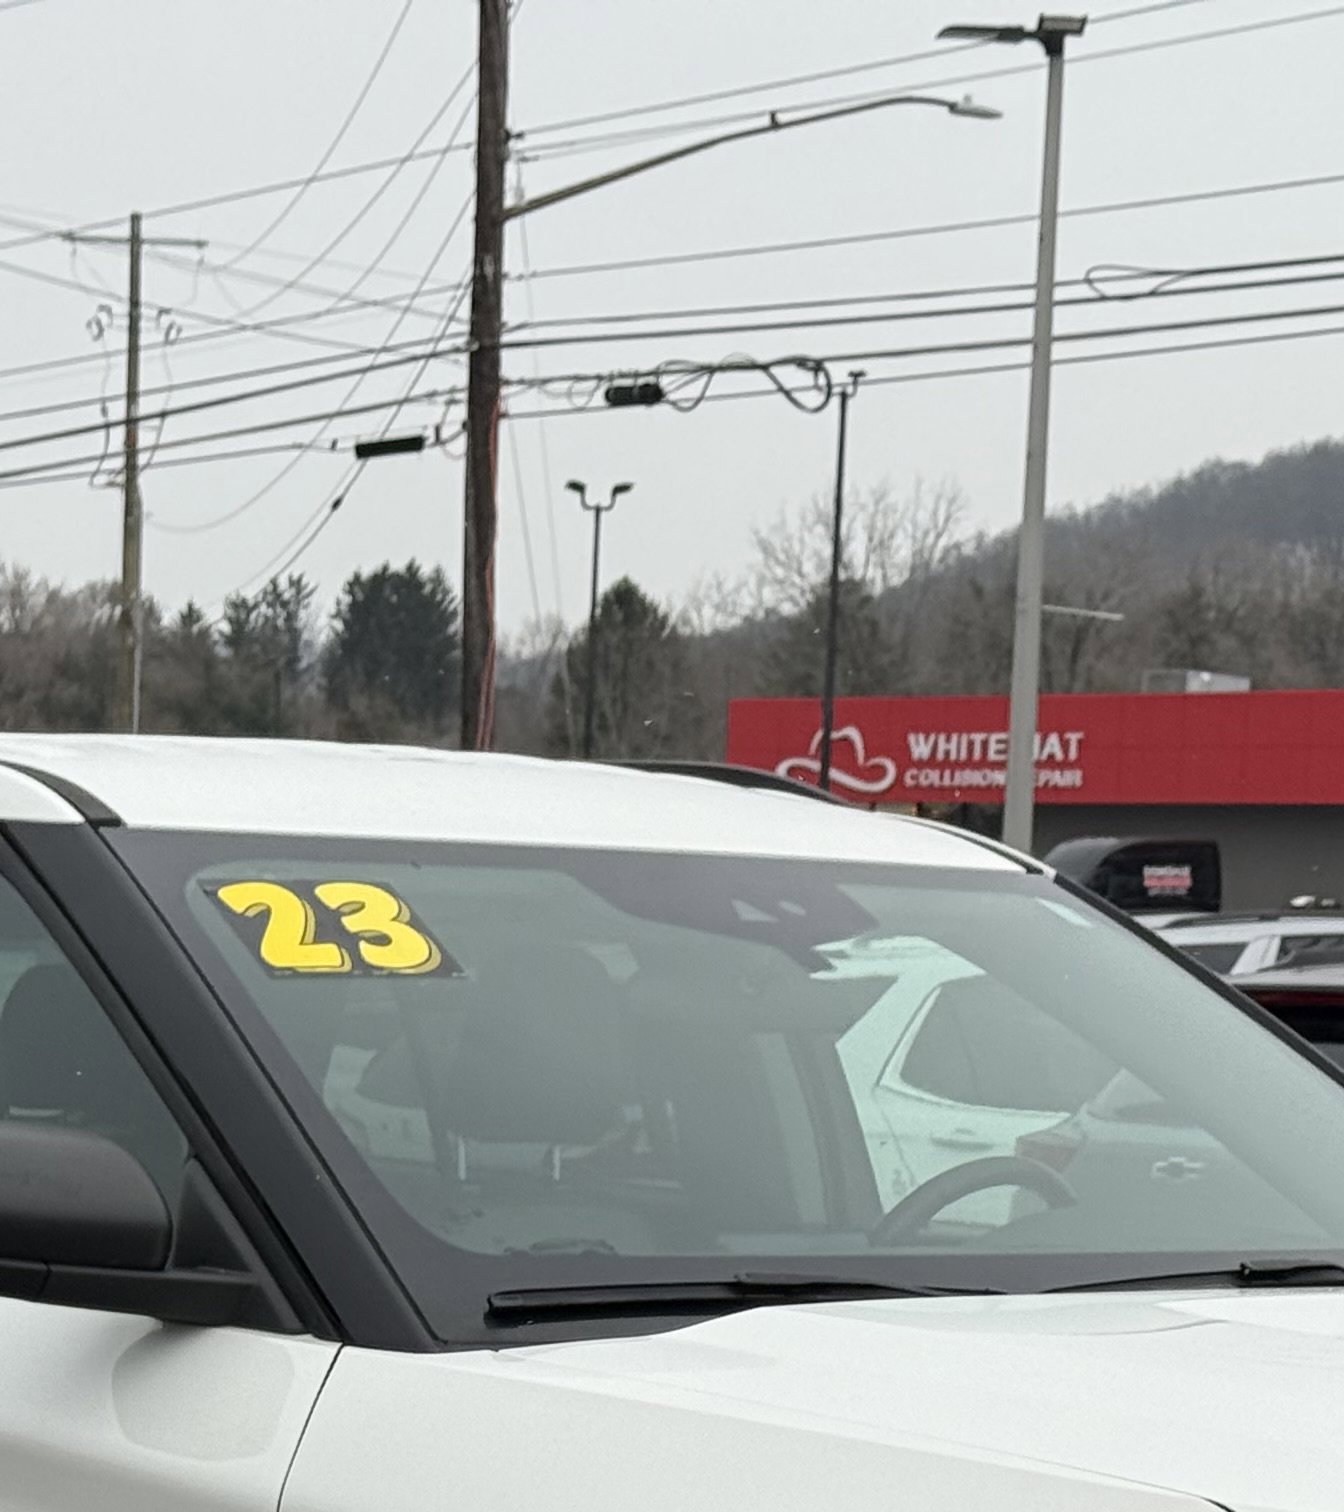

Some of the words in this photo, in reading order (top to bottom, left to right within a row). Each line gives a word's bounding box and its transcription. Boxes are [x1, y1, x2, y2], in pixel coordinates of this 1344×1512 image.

[907, 731, 1008, 763] WHITE
[903, 767, 1007, 789] COLLISION
[216, 880, 442, 975] 23
